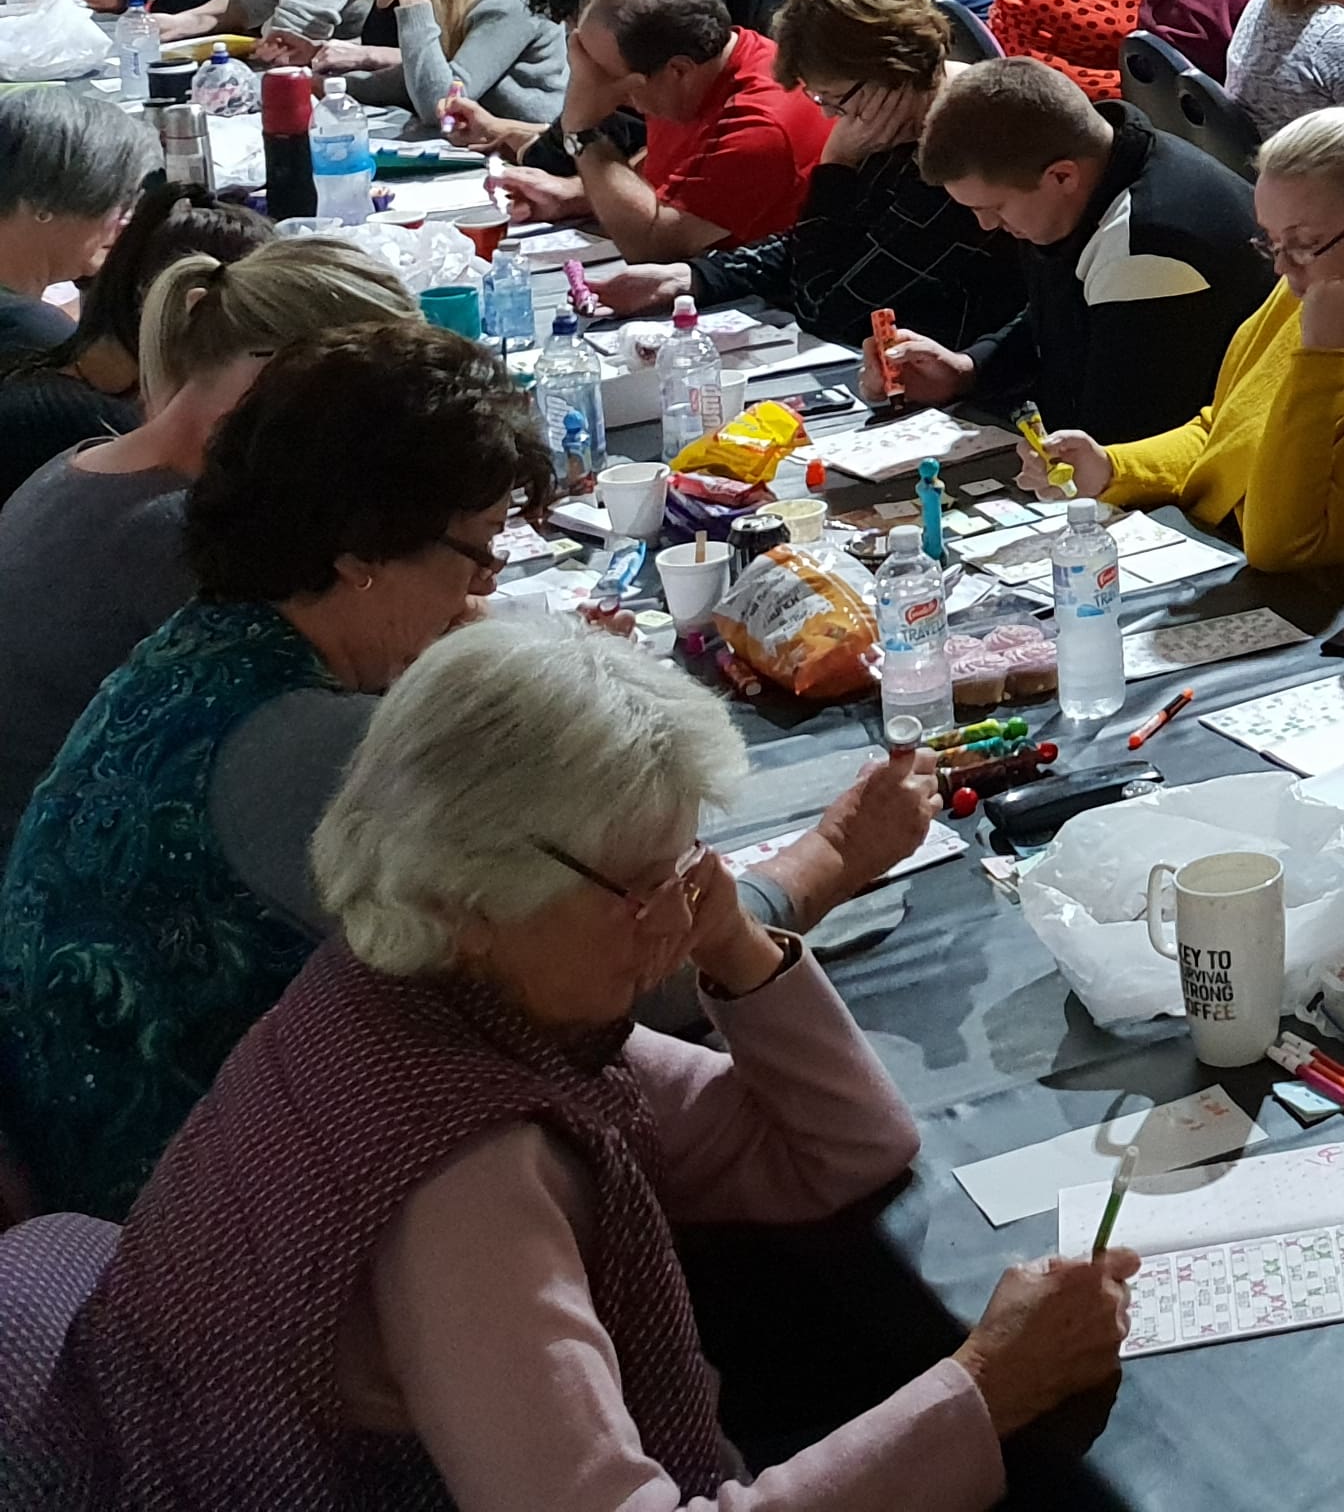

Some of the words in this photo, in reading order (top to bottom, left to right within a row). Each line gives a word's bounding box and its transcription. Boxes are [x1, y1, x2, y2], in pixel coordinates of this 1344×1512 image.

[1206, 950, 1232, 970] TO
[1183, 967, 1232, 985] RVIVAL
[1184, 979, 1234, 1002] TRONG
[1187, 999, 1237, 1021] OFFEE
